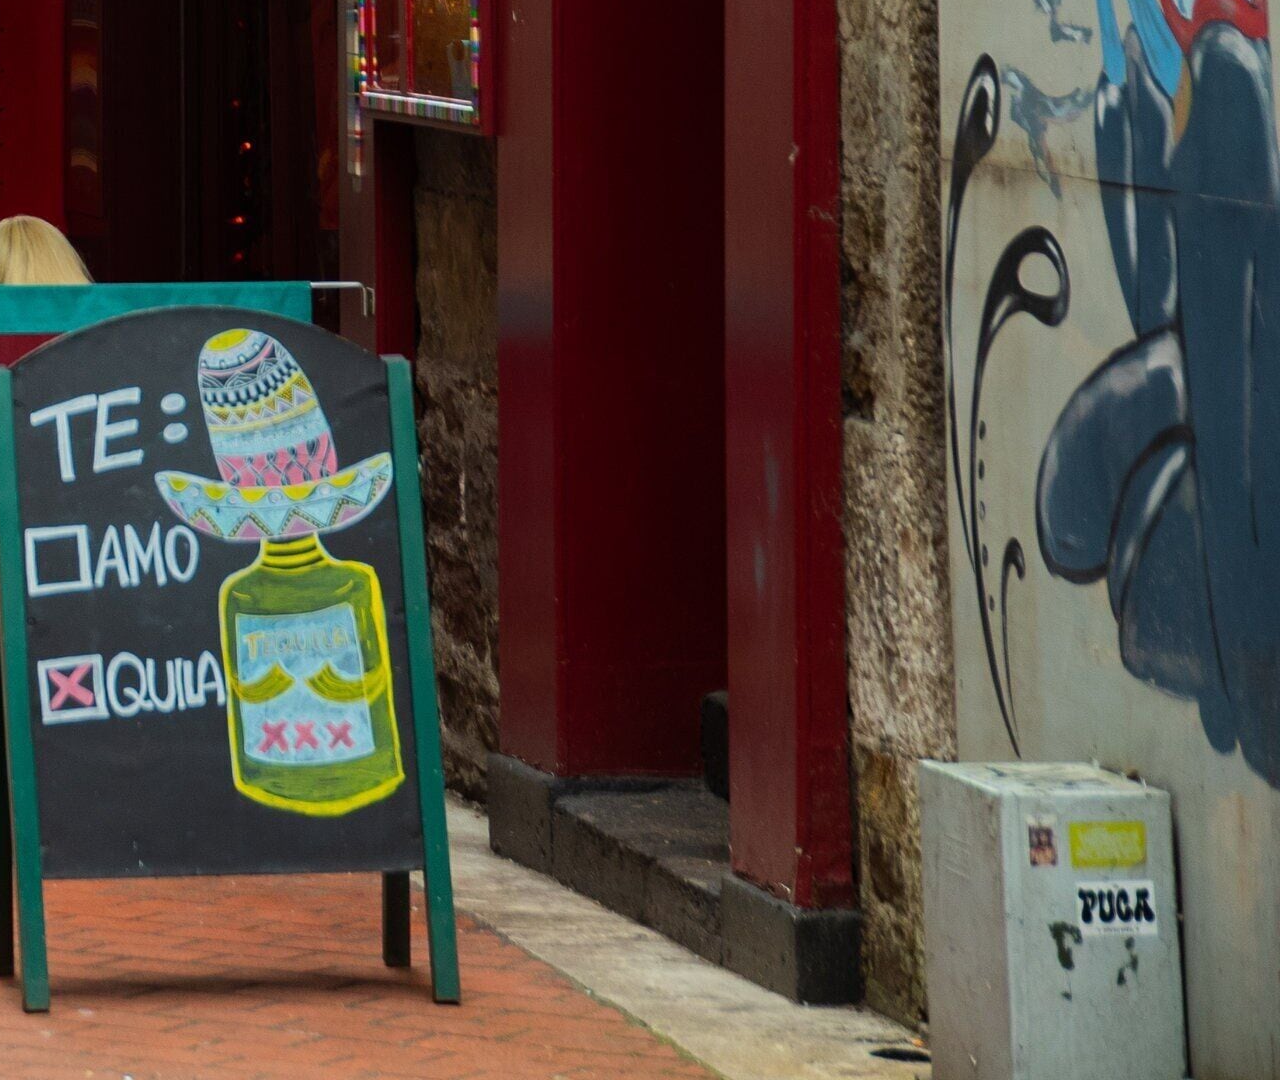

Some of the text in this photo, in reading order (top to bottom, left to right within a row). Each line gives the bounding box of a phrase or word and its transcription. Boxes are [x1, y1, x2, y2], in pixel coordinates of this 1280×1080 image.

[94, 520, 200, 589] AMO
[243, 626, 350, 661] TEQUILA
[106, 649, 227, 722] QUILA
